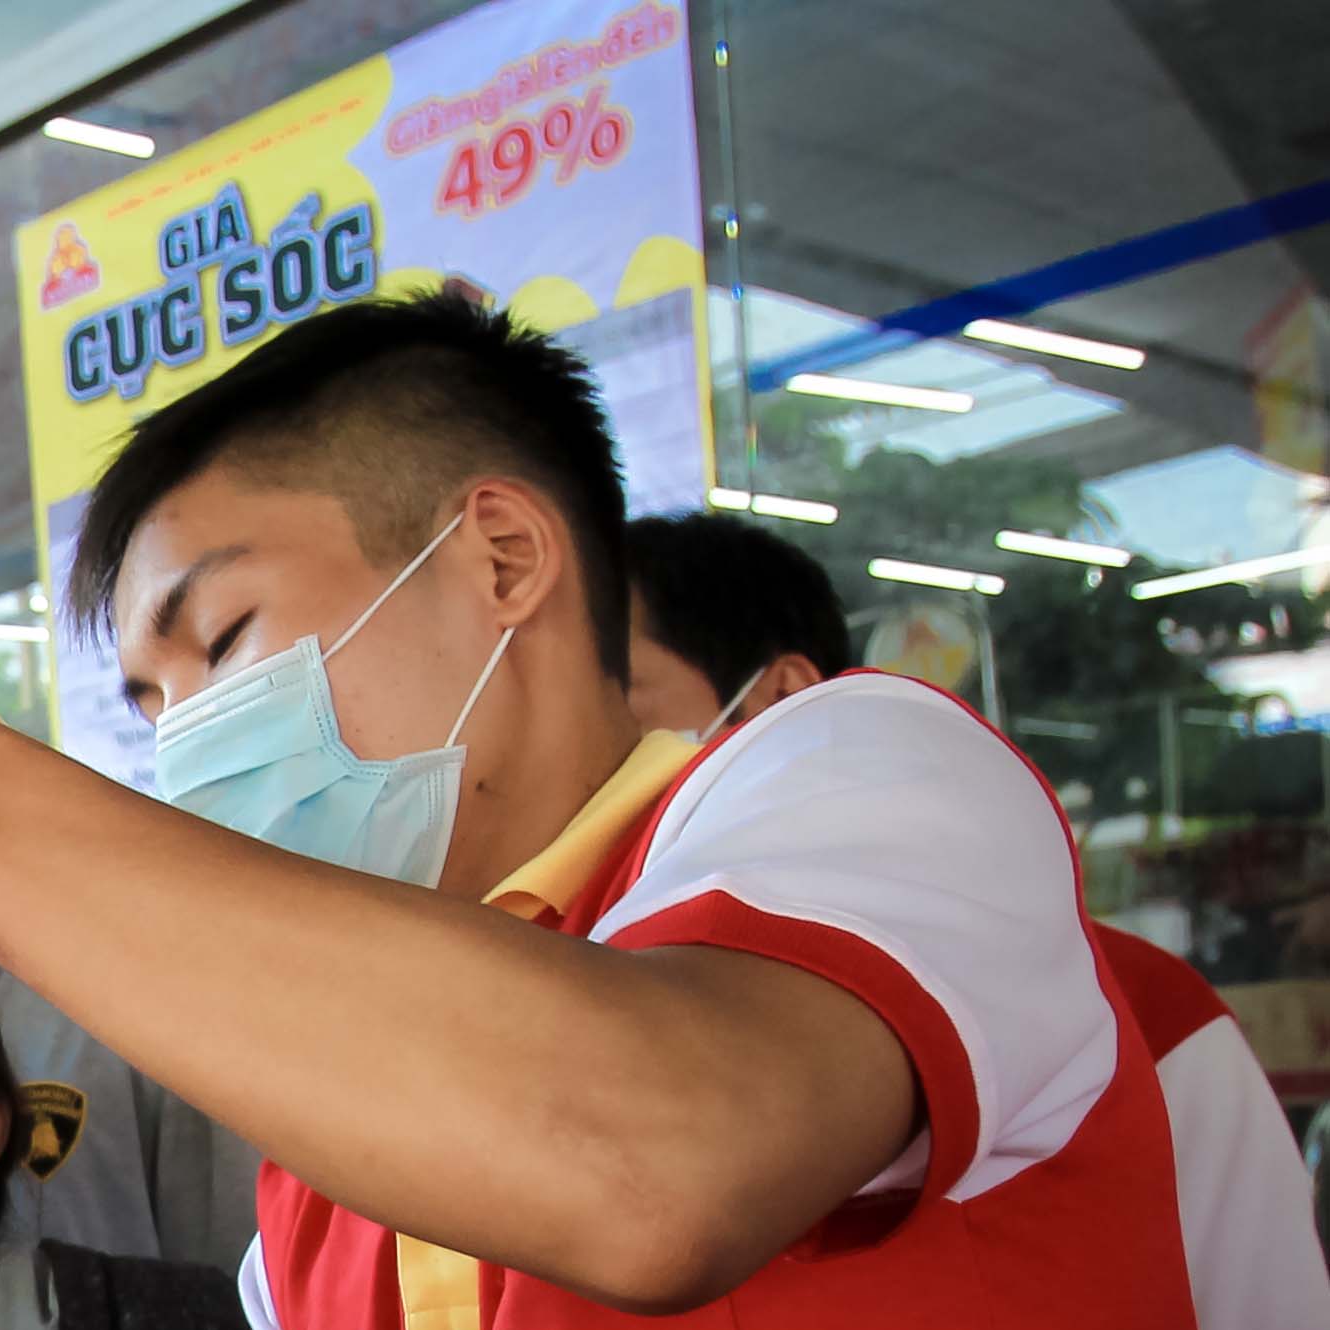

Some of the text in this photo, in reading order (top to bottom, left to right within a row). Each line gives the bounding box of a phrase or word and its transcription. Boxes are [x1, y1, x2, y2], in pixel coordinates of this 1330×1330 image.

[437, 84, 630, 215] 49%
[66, 189, 375, 399] CỰC SỐC
